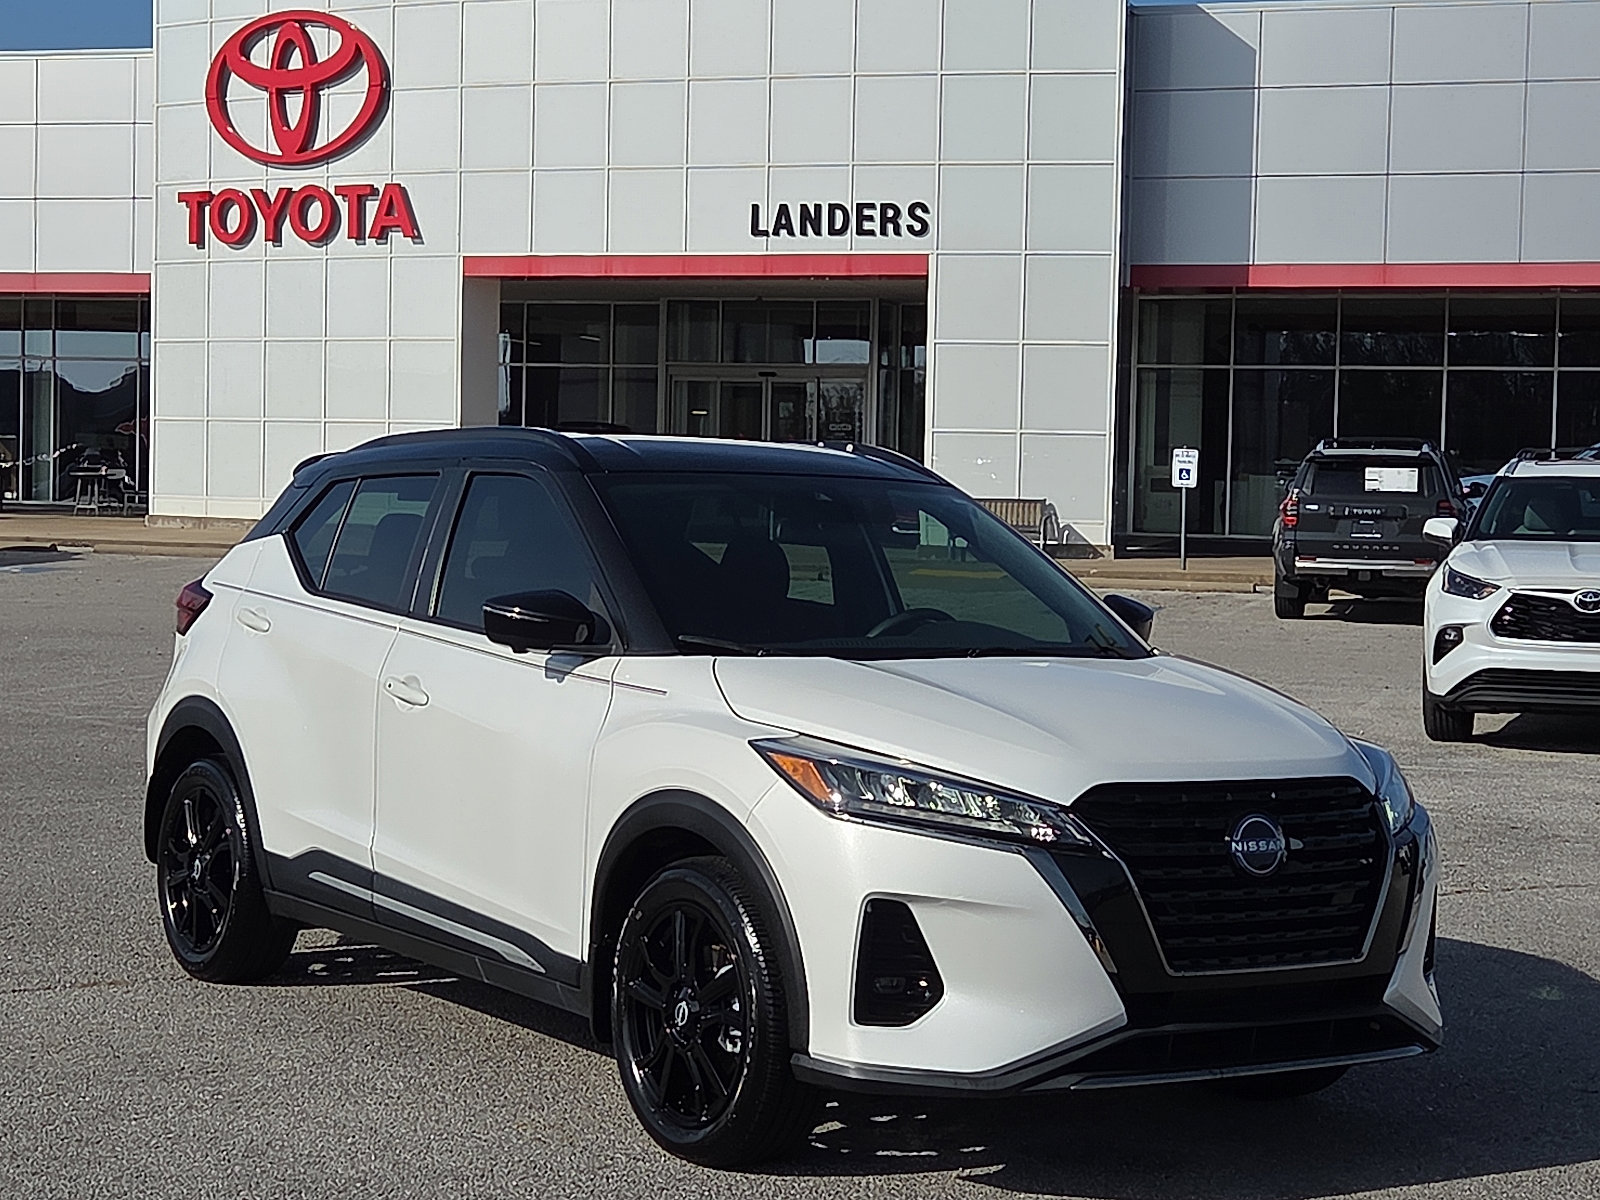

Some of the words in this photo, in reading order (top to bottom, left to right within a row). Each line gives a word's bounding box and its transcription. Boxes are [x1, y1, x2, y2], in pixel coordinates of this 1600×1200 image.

[178, 183, 423, 250] TOYOTA
[750, 201, 931, 238] LANDERS
[1231, 840, 1284, 852] NISSAN
